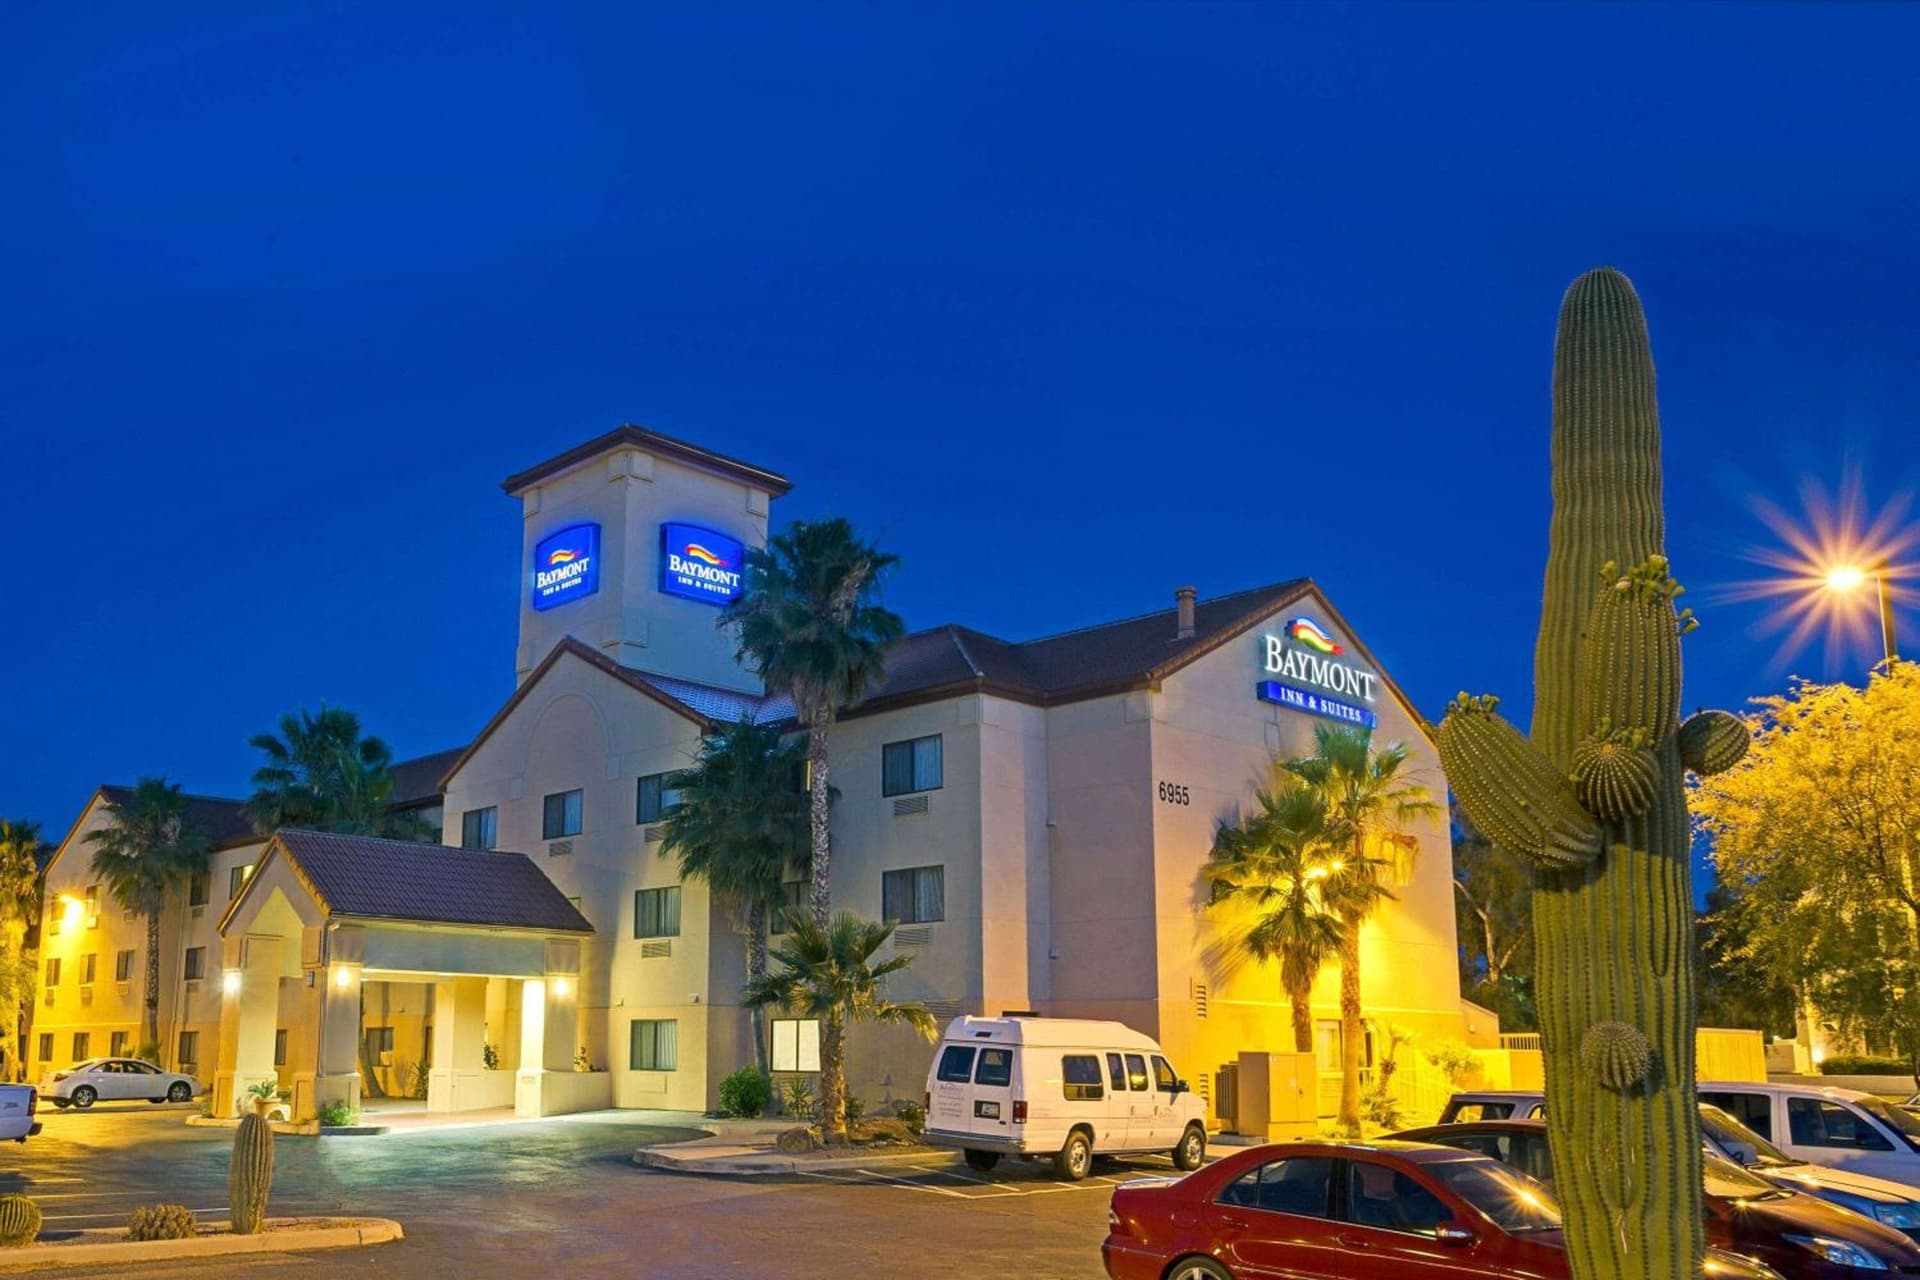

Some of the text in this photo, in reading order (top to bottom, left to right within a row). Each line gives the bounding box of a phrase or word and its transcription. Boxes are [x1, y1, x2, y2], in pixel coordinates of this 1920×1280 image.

[537, 558, 589, 589] BAYMONT
[669, 554, 740, 587] BAYMONT
[1265, 634, 1376, 701] BAYMONT
[1281, 687, 1361, 722] INN & SUITES
[1159, 781, 1189, 806] 6955
